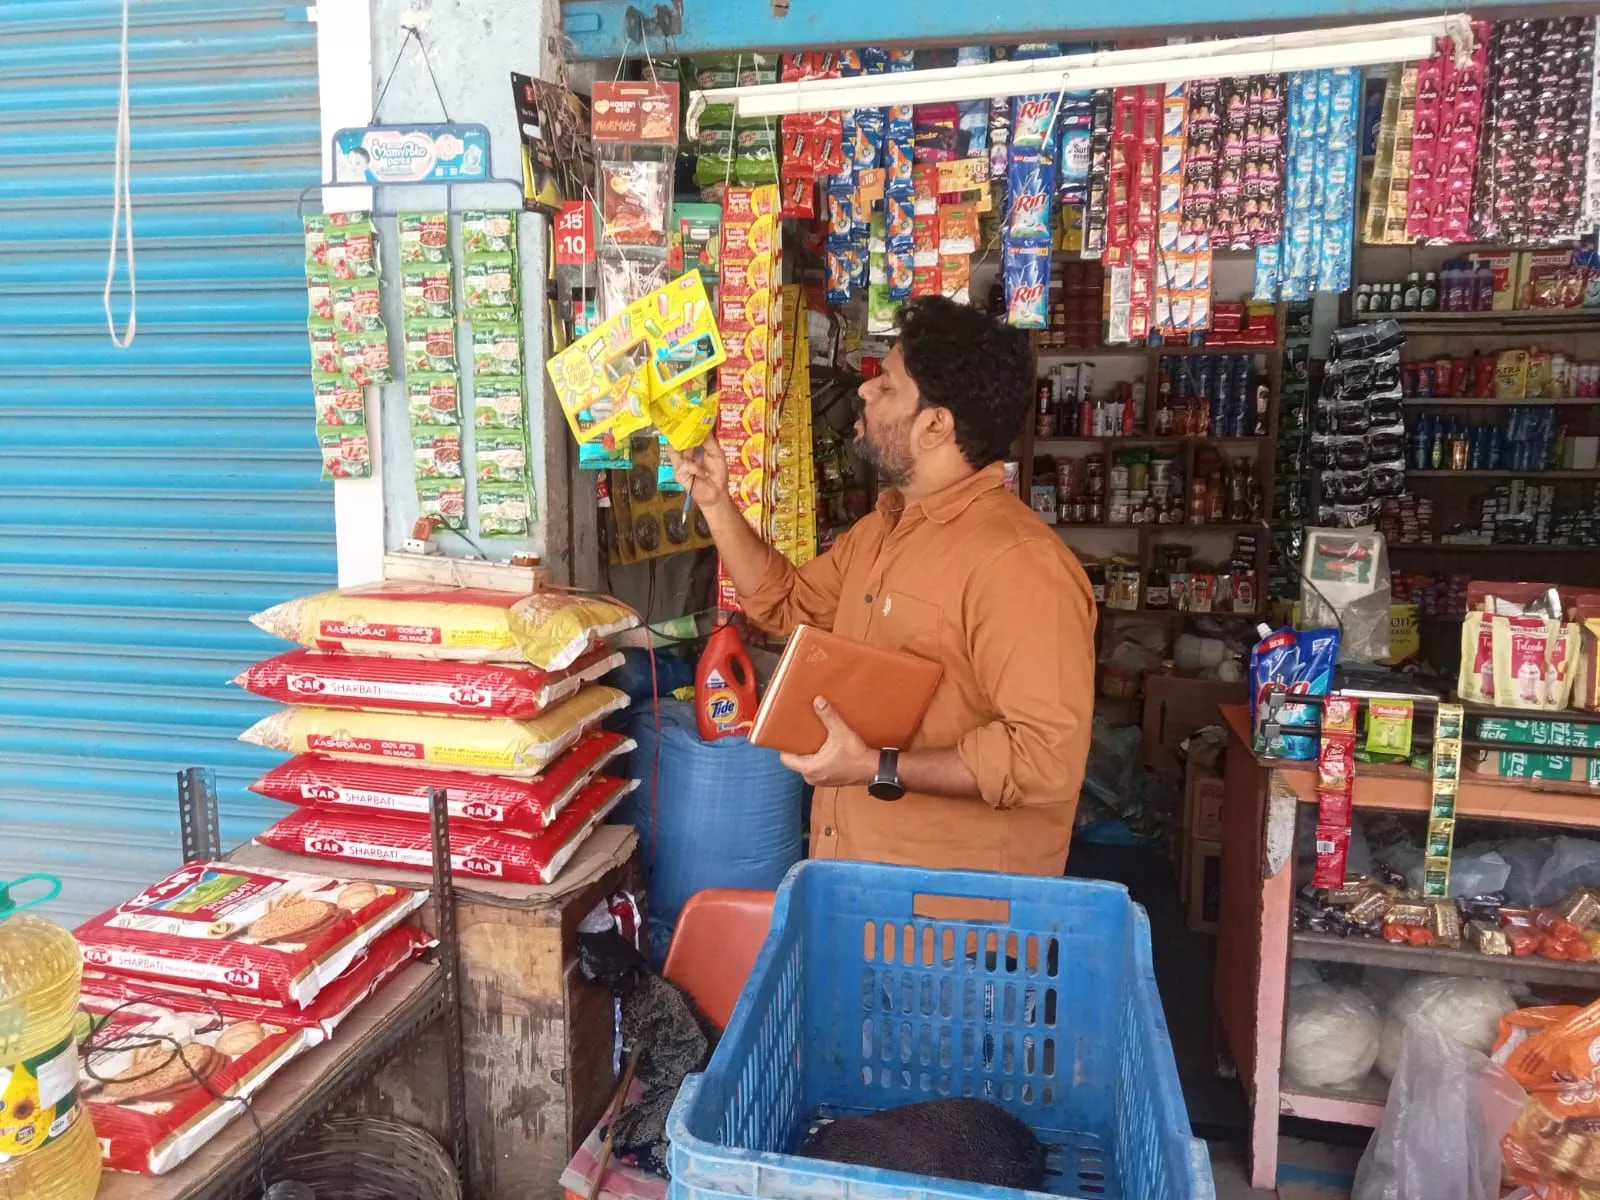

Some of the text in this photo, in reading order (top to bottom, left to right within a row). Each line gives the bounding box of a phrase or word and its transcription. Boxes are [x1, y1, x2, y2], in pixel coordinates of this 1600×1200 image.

[1020, 100, 1053, 118] Rin
[1016, 192, 1047, 211] Rin
[1014, 284, 1045, 302] Rin
[325, 625, 387, 637] AASHIRVAAD
[330, 682, 382, 696] SHARBATI
[453, 690, 480, 703] RAR
[711, 700, 735, 718] Tide
[313, 739, 372, 751] AASHIRVAAD
[345, 792, 395, 807] SHARBATI
[466, 804, 492, 817] RAR
[348, 845, 399, 859] SHARBATI
[466, 859, 492, 873] RAR
[127, 871, 200, 907] RAR
[118, 957, 164, 972] SHARBATI
[226, 971, 251, 984] RAR
